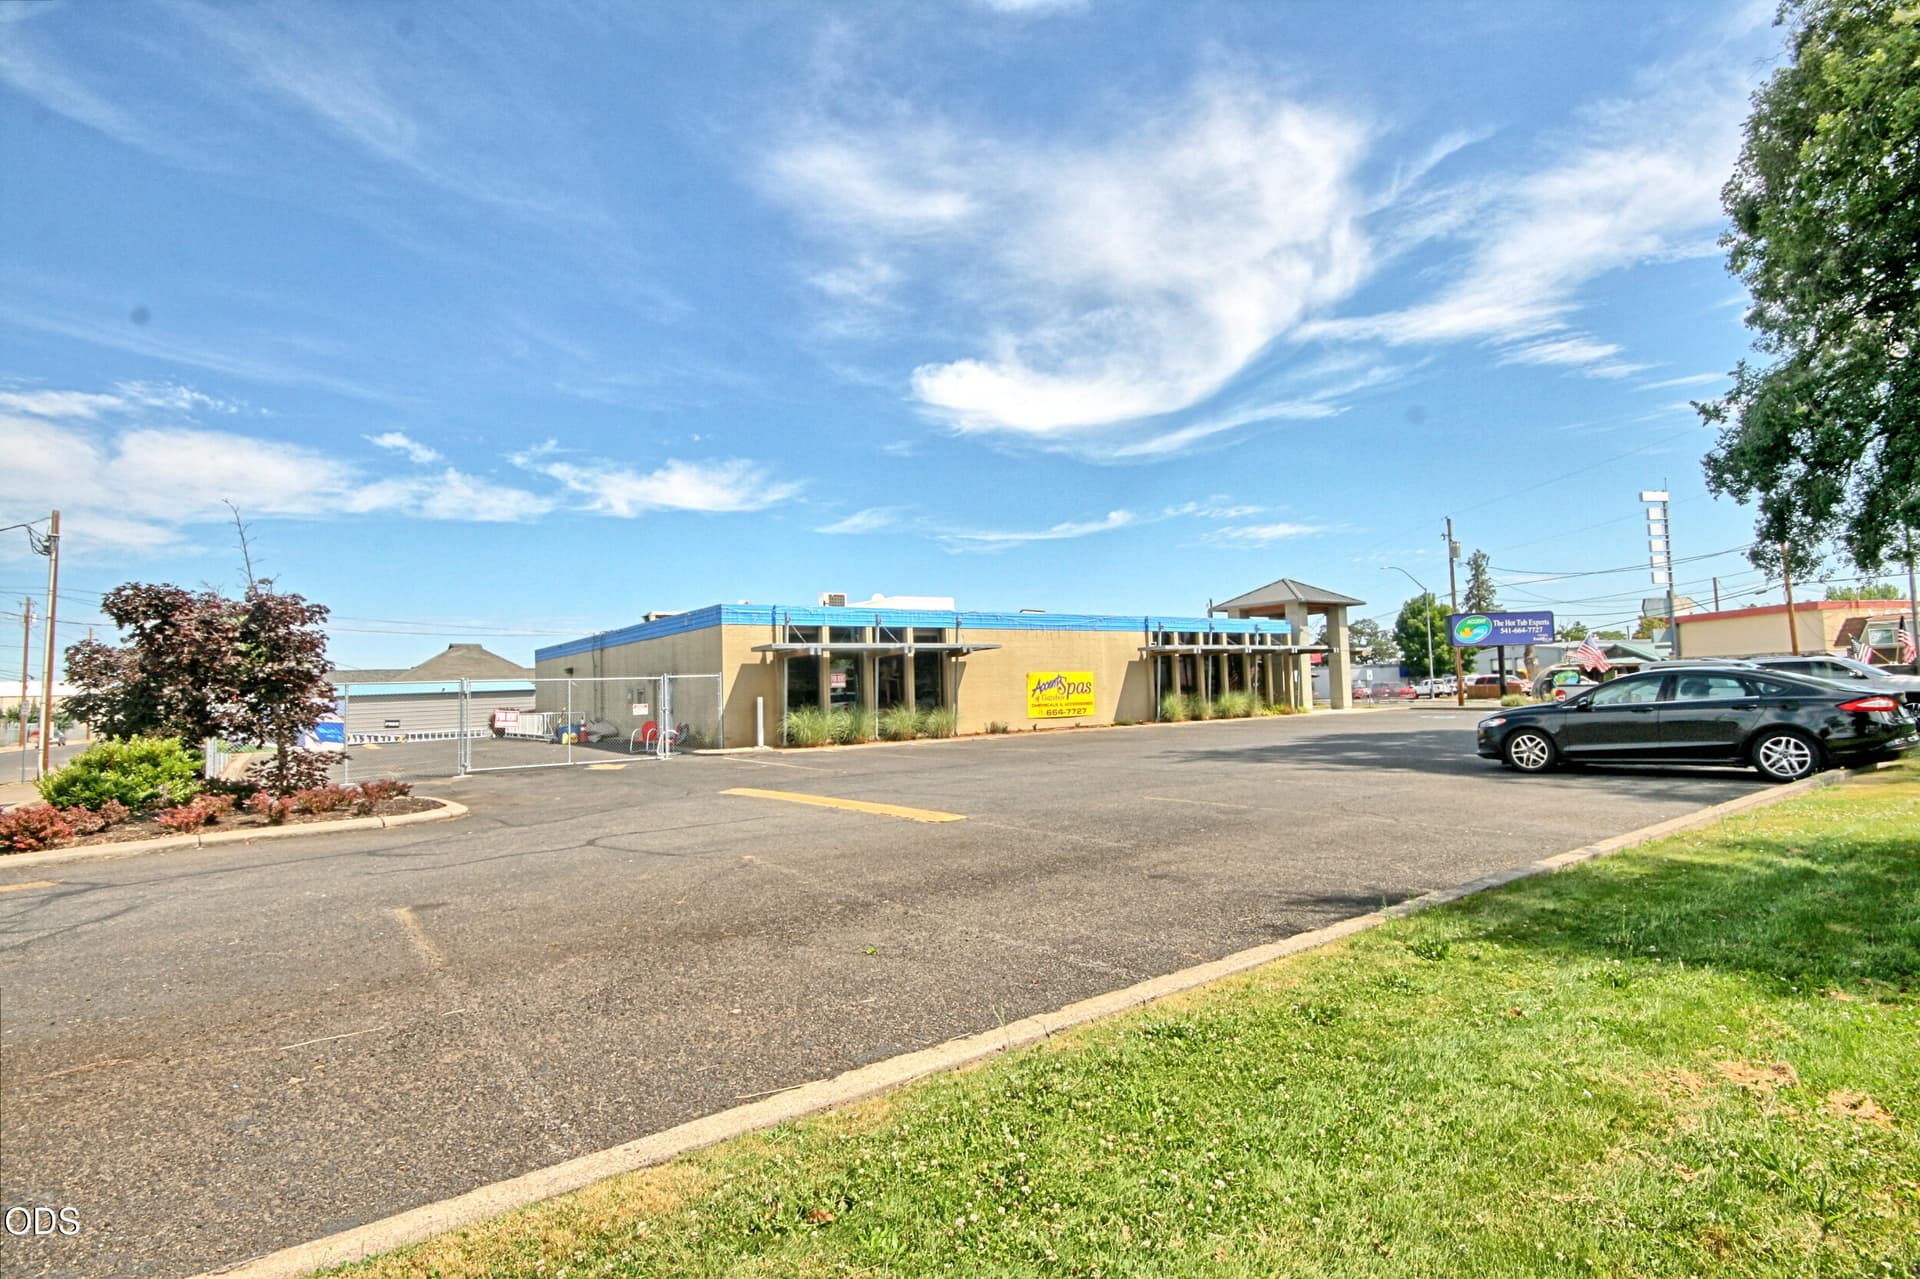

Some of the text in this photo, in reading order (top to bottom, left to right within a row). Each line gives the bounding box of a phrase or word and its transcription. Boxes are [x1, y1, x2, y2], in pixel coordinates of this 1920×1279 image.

[1493, 619, 1504, 627] The
[1516, 618, 1528, 626] Tub
[1528, 618, 1550, 627] Experts
[1500, 626, 1543, 634] 541-664-7727
[1057, 677, 1092, 700] Spas
